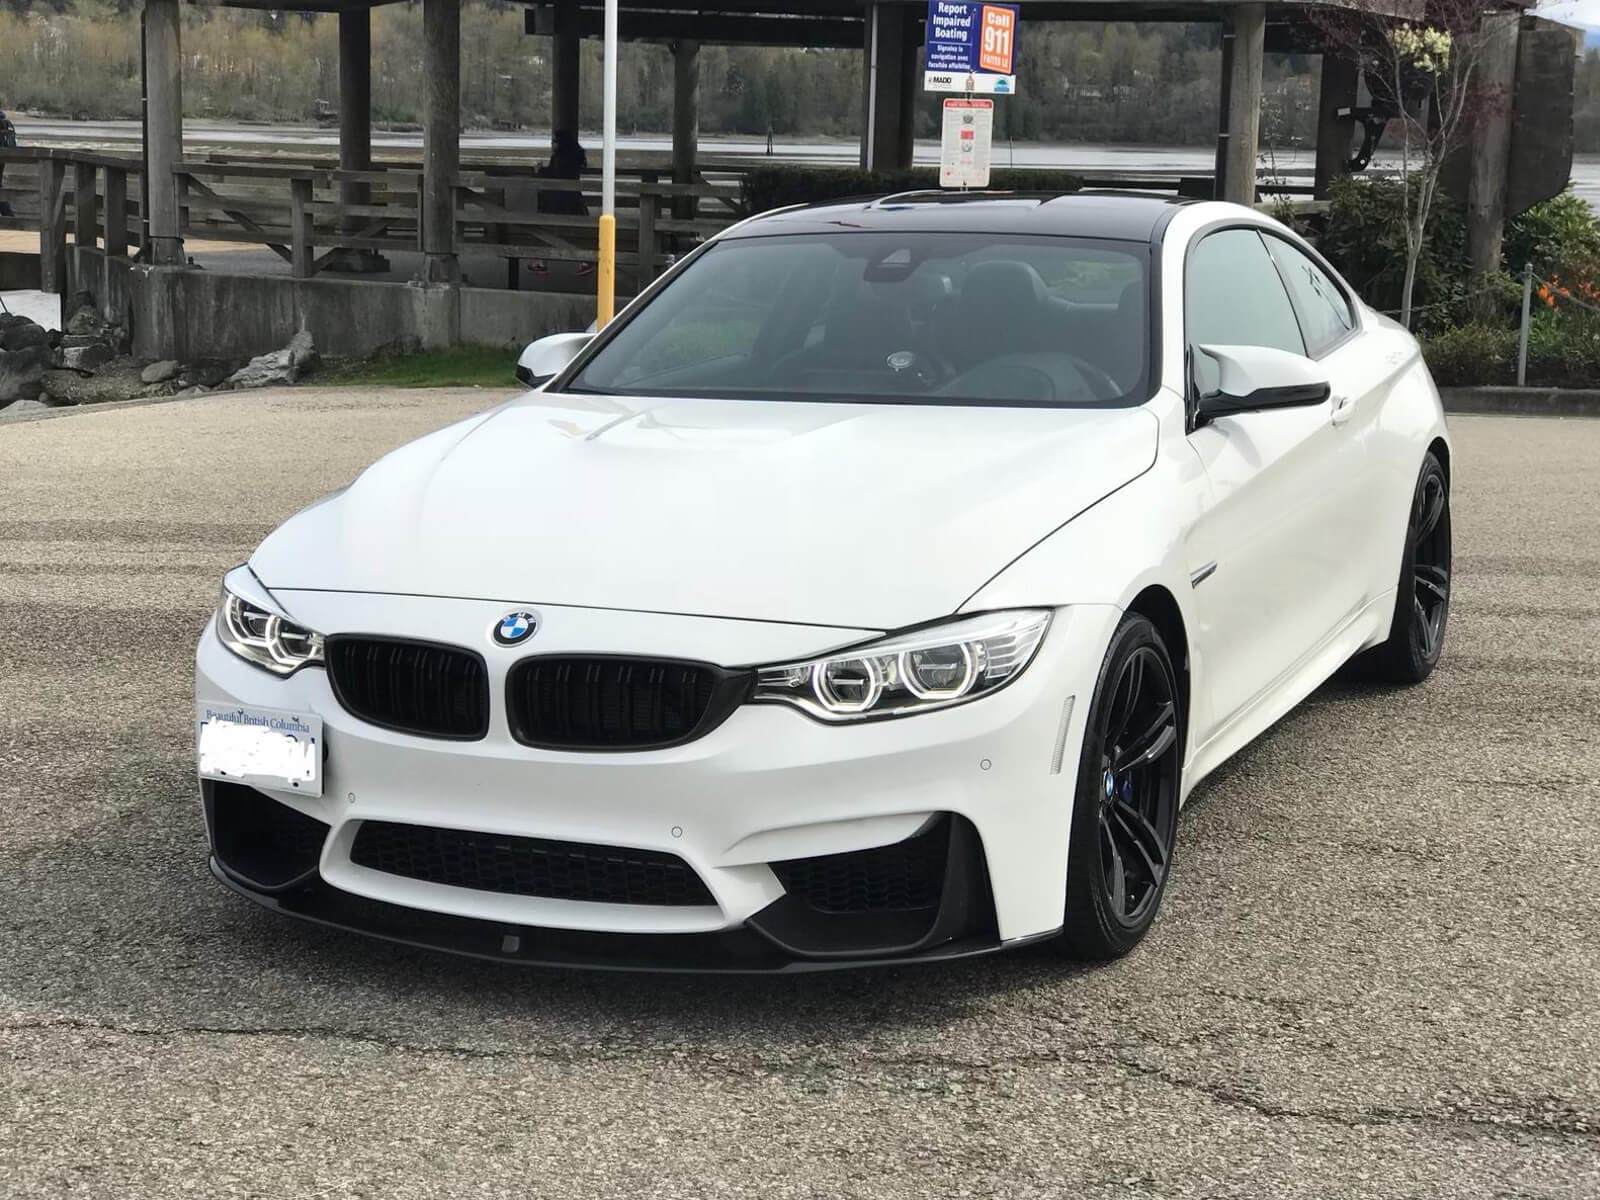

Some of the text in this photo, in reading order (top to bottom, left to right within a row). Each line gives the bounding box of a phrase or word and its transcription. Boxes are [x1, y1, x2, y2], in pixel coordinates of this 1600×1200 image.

[938, 2, 967, 15] Report
[933, 14, 971, 27] Impaired
[987, 12, 1010, 27] Call
[935, 27, 967, 41] Boating
[984, 26, 1010, 56] 911
[933, 76, 952, 84] MADD
[243, 714, 269, 726] British
[270, 718, 310, 732] Columbia
